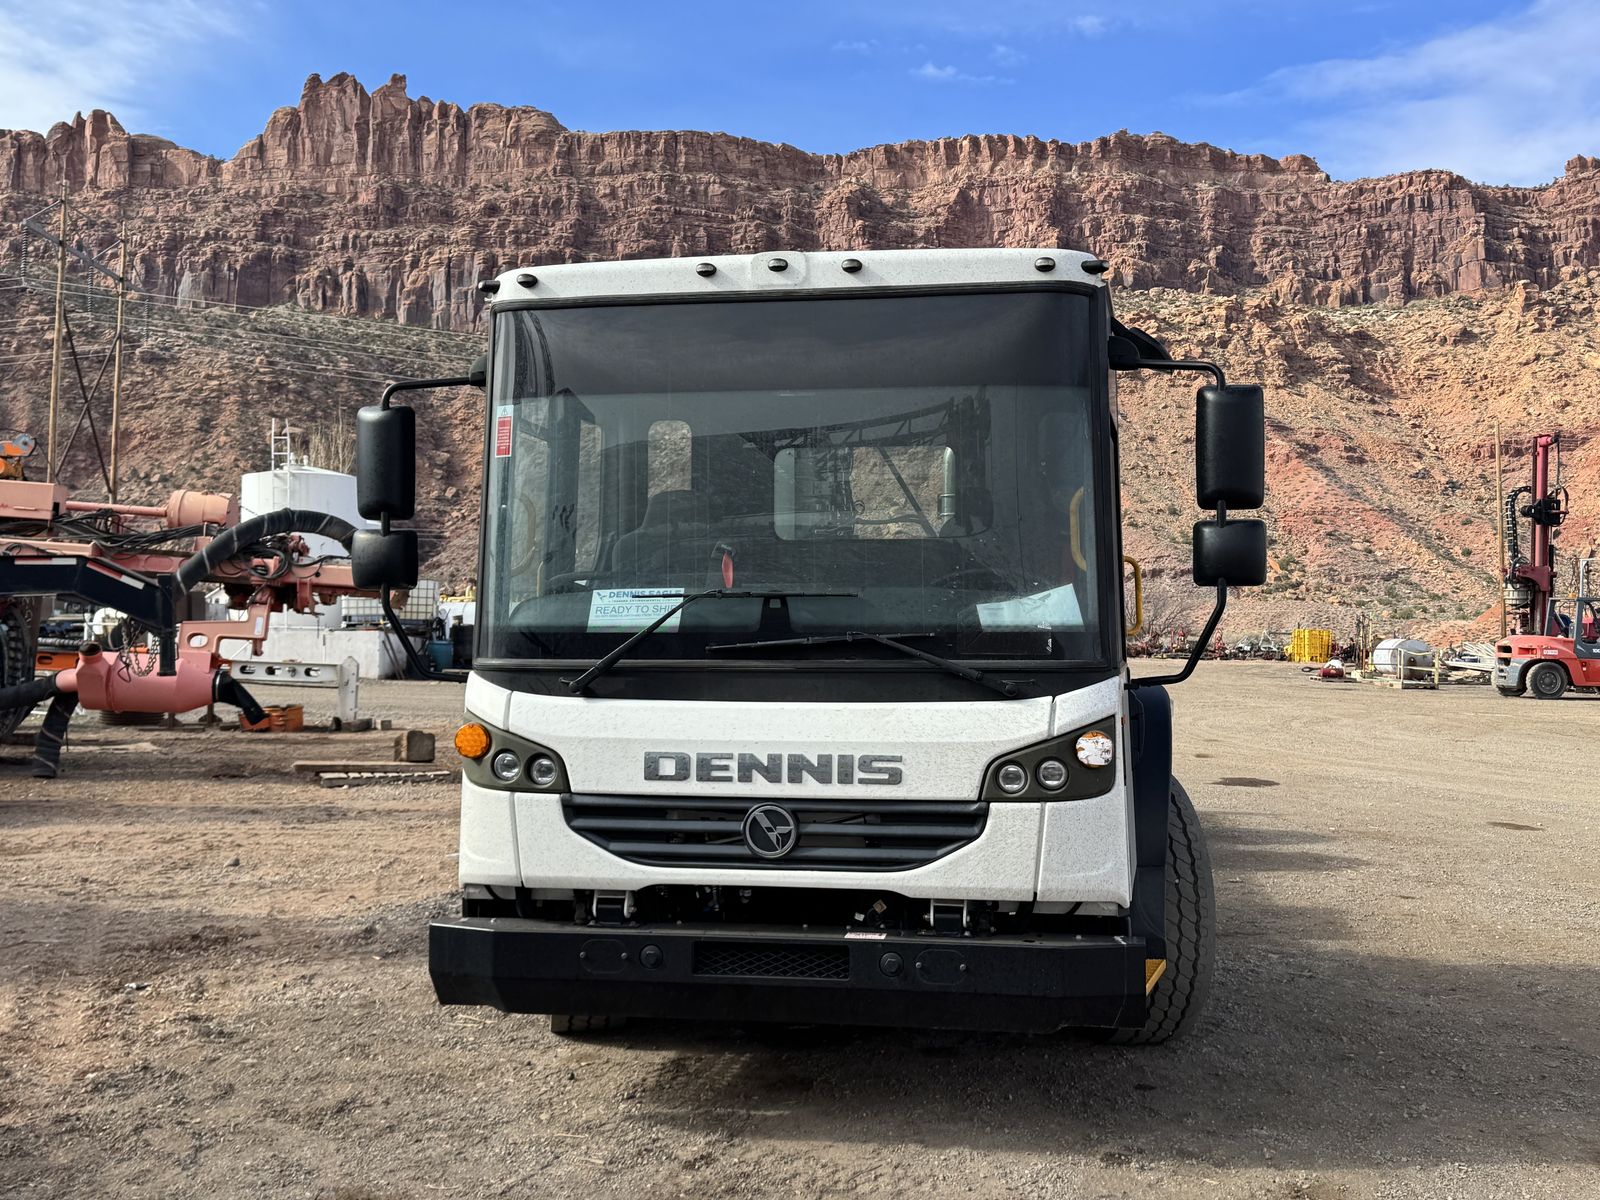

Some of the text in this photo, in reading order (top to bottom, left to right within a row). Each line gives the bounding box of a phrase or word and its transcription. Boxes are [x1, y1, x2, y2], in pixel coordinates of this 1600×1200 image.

[595, 606, 633, 615] READY
[635, 605, 650, 613] TO
[643, 751, 903, 785] DENNIS
